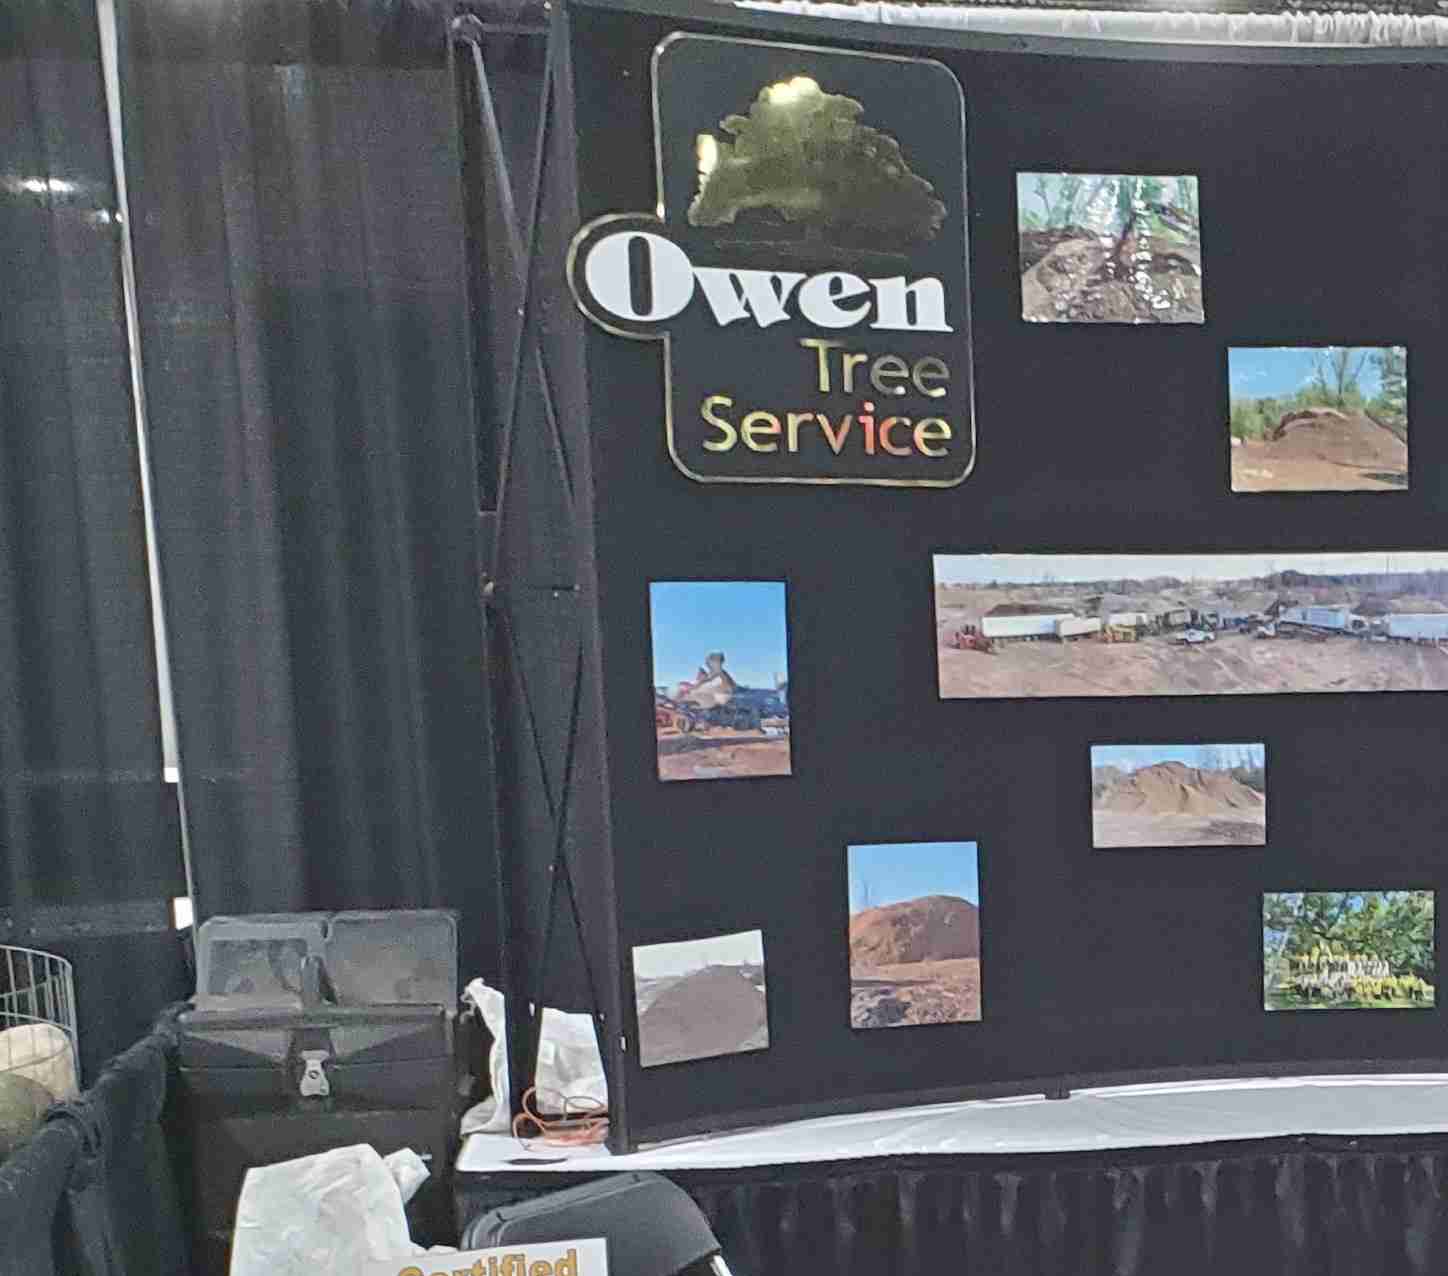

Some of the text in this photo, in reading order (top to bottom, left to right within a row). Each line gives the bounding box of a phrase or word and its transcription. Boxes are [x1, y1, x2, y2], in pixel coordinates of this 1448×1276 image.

[585, 231, 953, 332] Owen
[800, 338, 949, 397] Tree
[702, 395, 952, 456] Service
